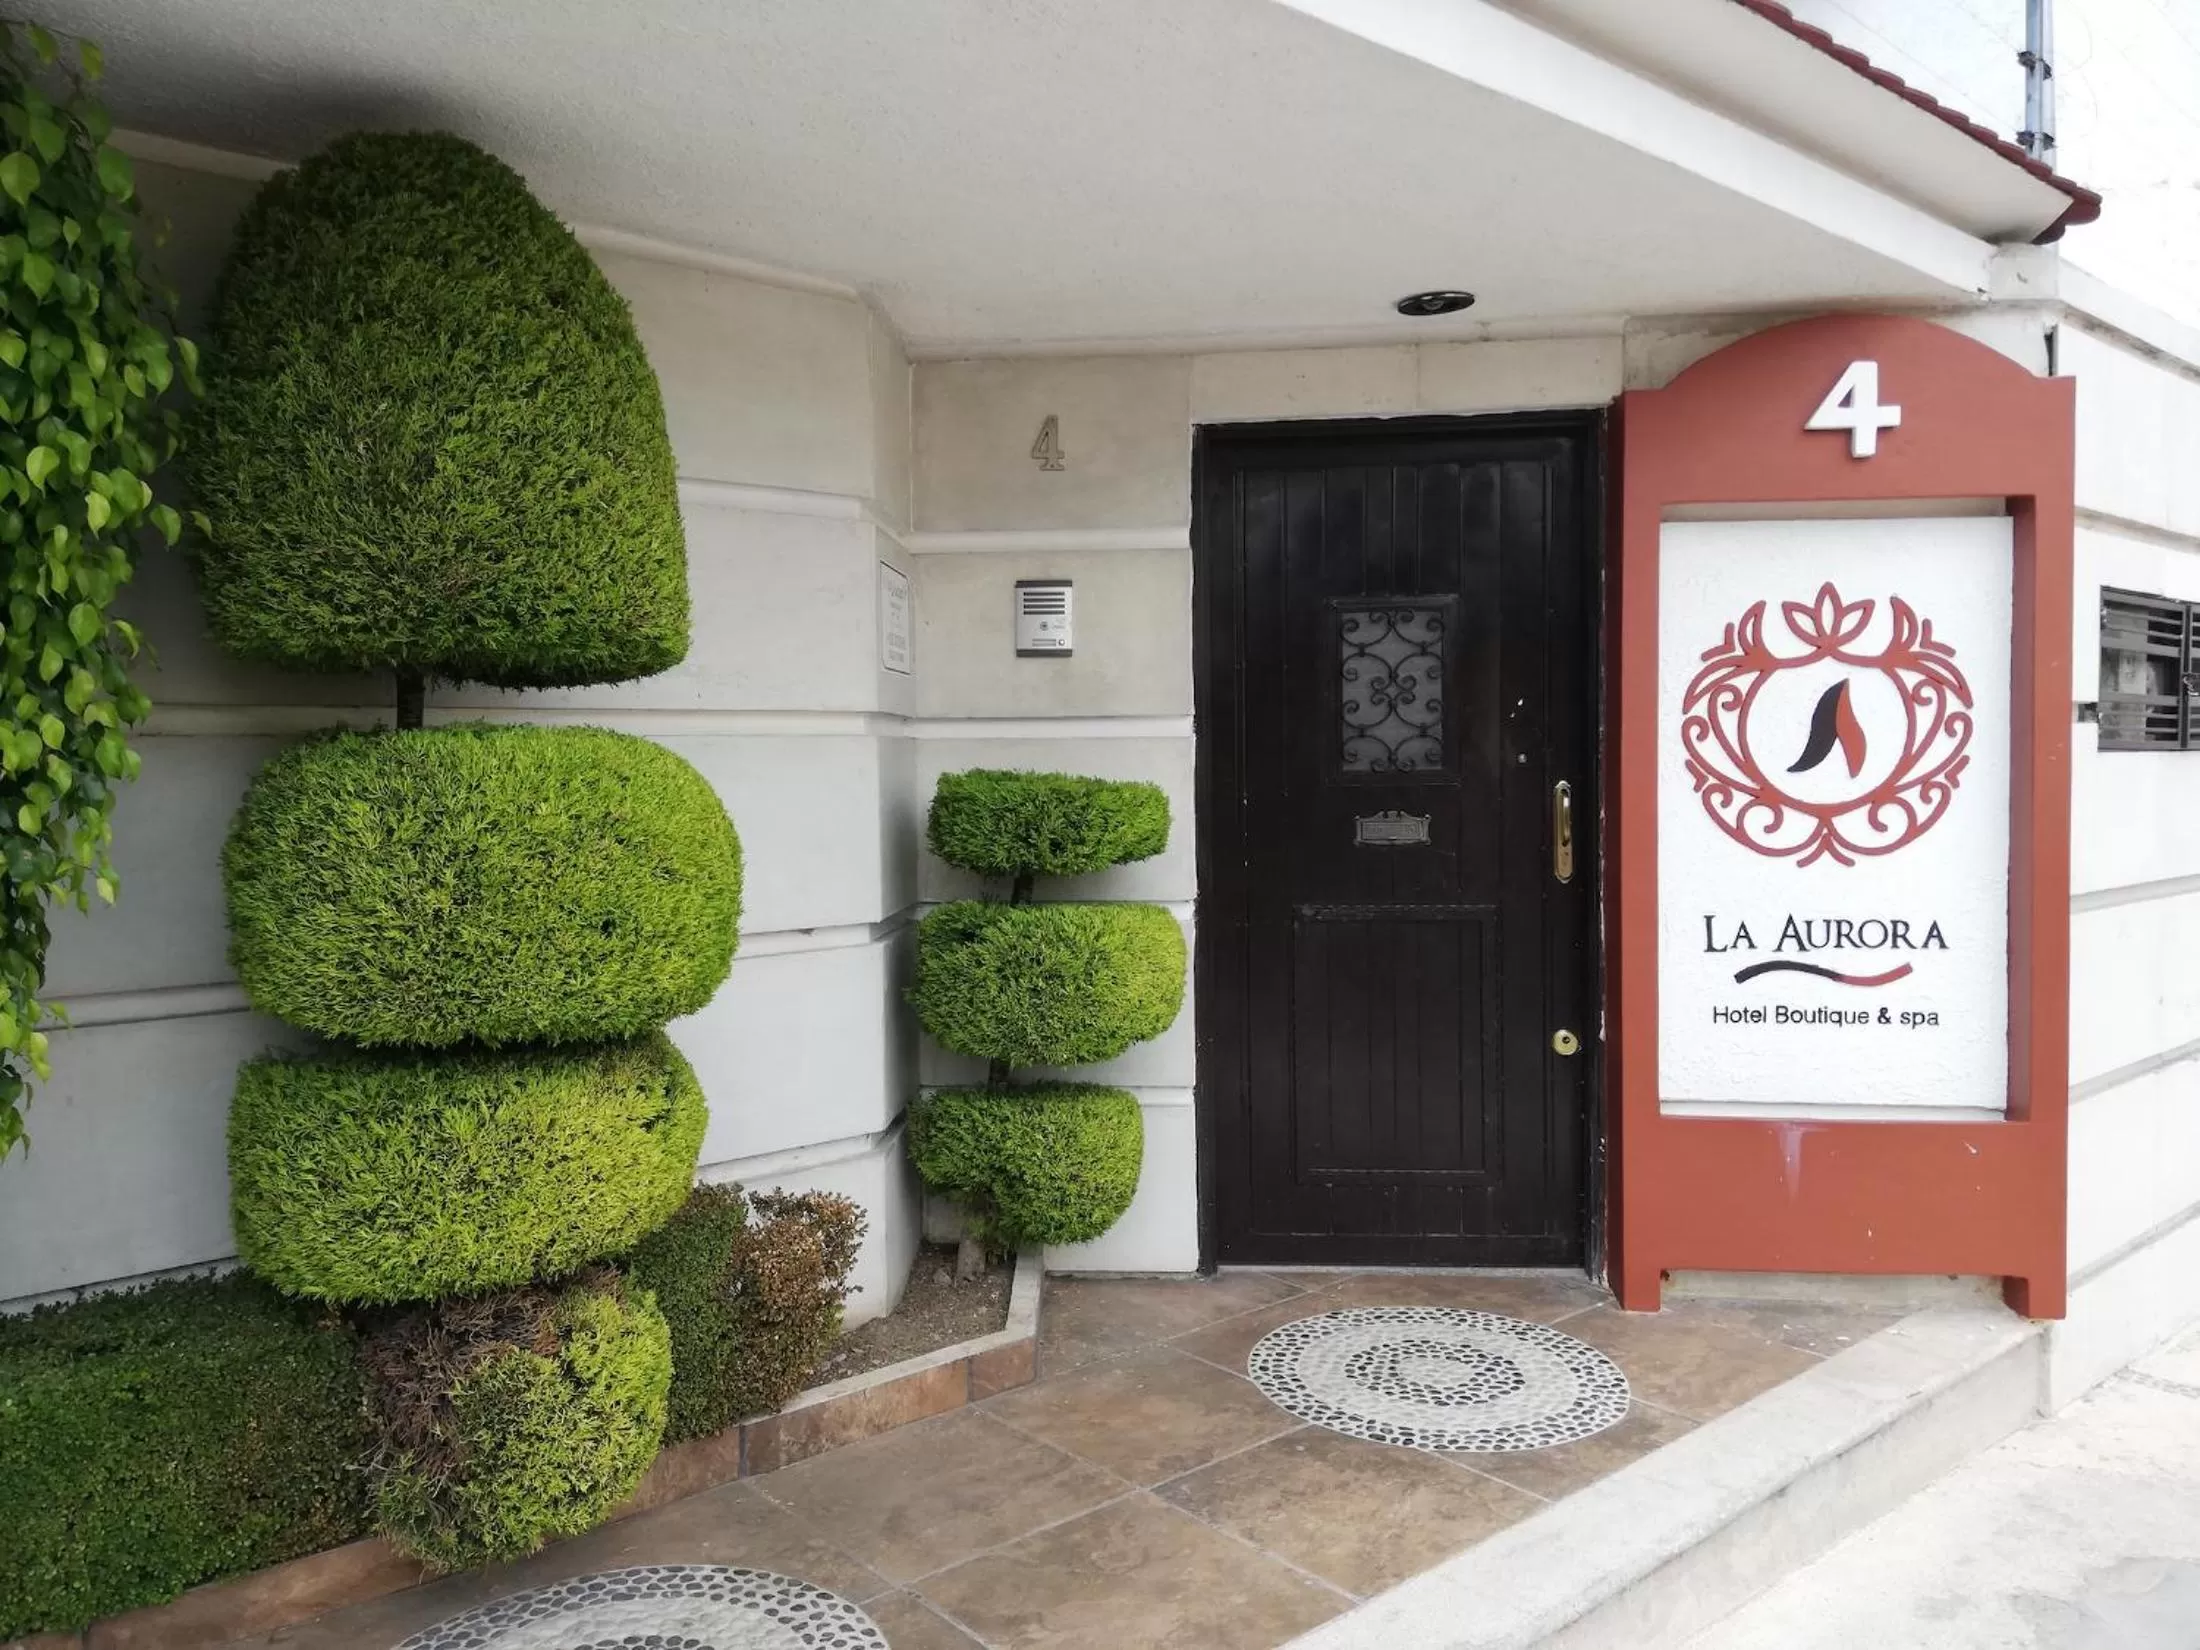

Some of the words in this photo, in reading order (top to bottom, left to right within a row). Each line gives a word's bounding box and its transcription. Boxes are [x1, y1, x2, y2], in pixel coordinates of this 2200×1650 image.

[1804, 360, 1902, 459] 4
[1031, 414, 1065, 471] 4
[1712, 1005, 1767, 1025] Hotel
[1775, 1004, 1870, 1028] Boutique
[1876, 1006, 1892, 1025] &
[1899, 1011, 1940, 1030] spa
